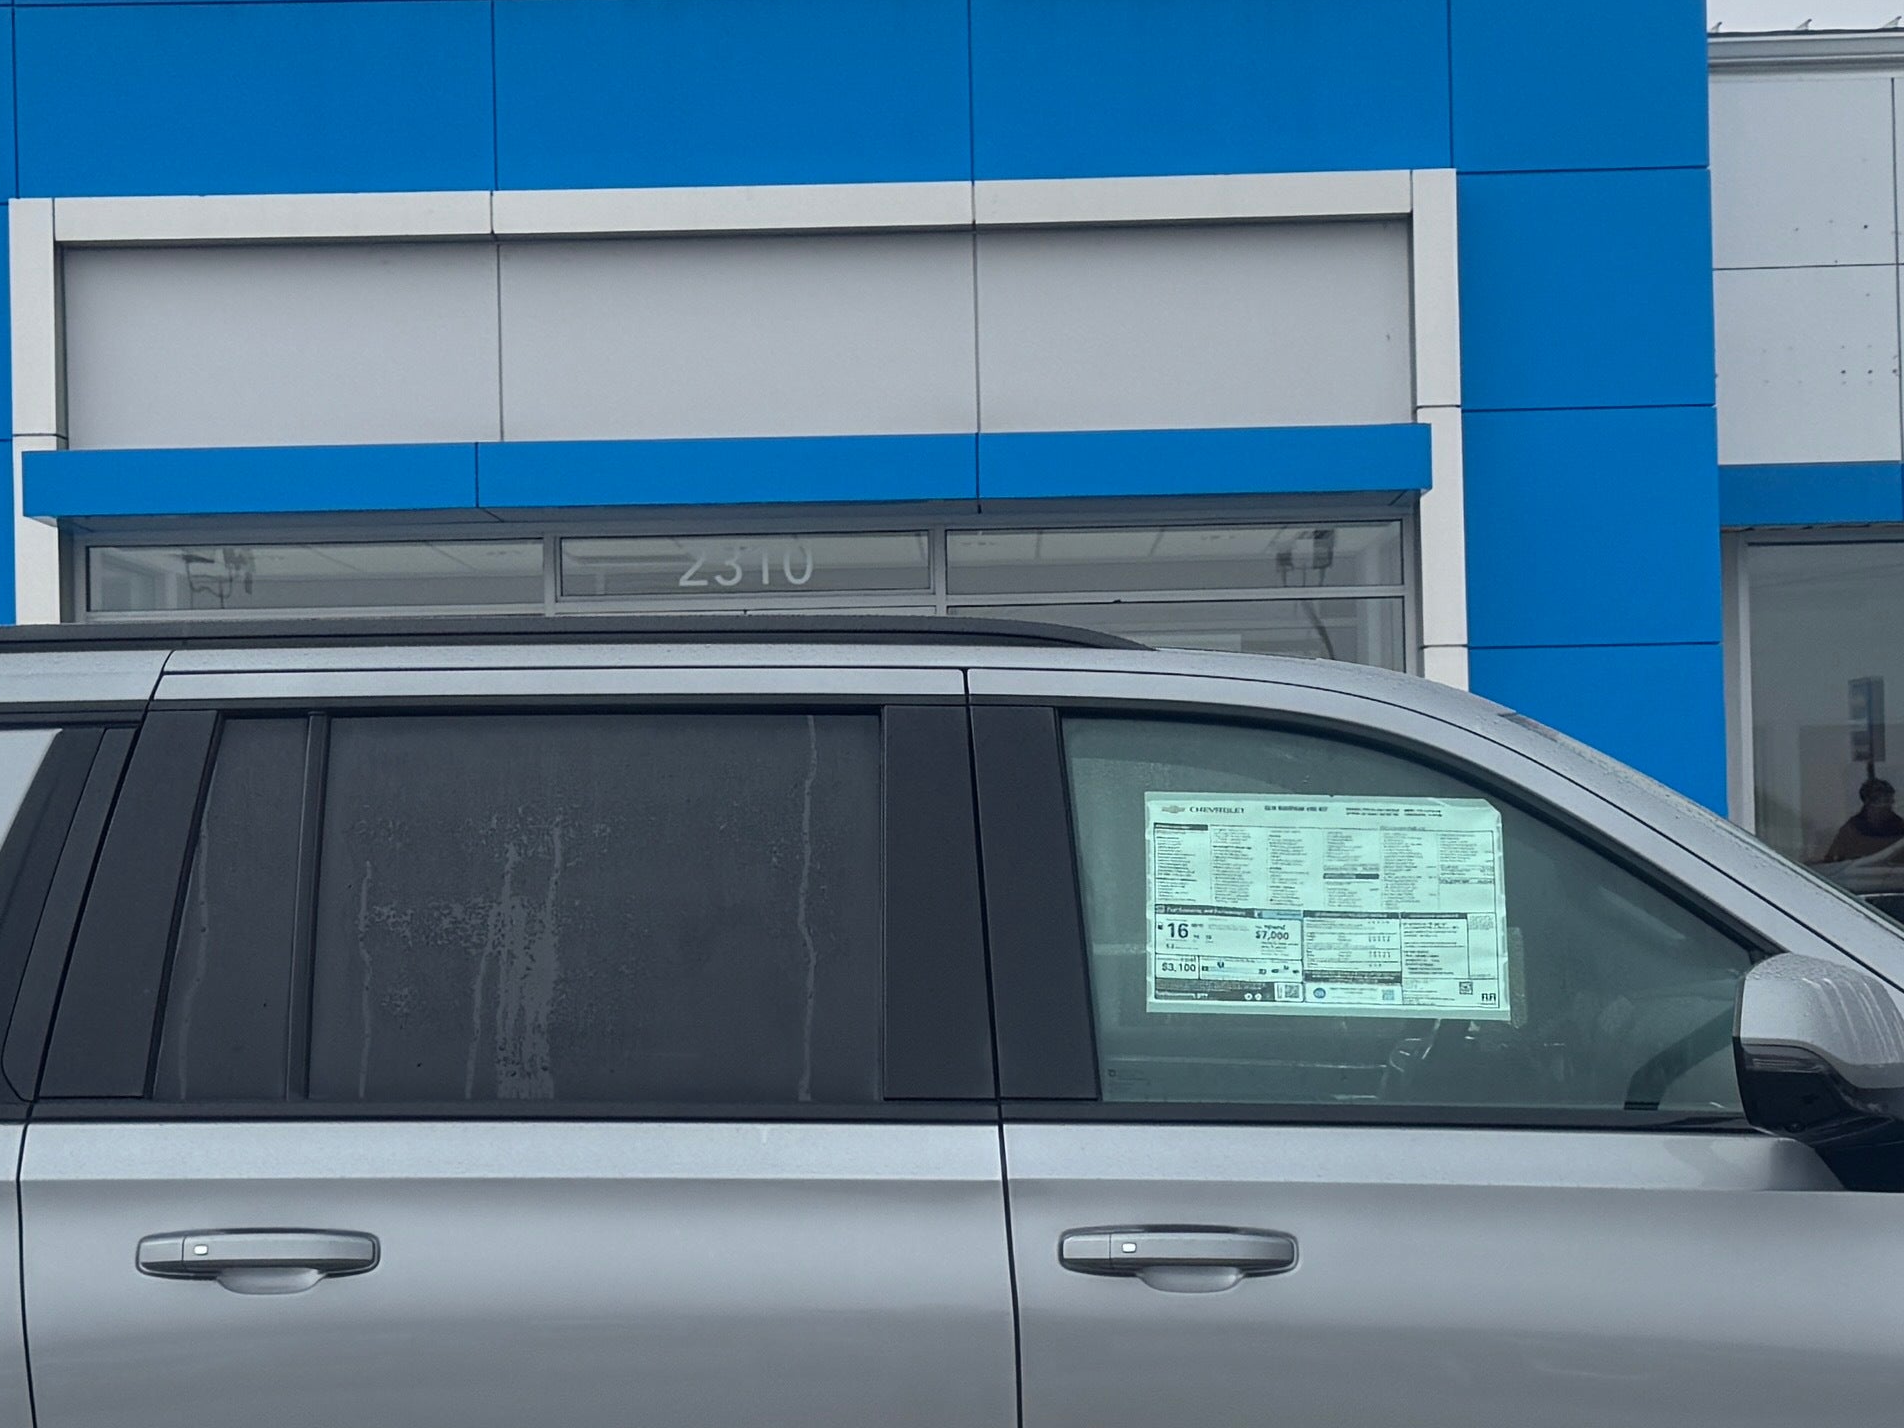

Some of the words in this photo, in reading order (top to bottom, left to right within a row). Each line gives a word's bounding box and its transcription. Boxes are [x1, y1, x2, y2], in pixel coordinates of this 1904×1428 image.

[678, 545, 814, 586] 2310
[1167, 922, 1189, 939] 16
[1255, 930, 1290, 941] $7,000
[1161, 961, 1197, 972] $3,100
